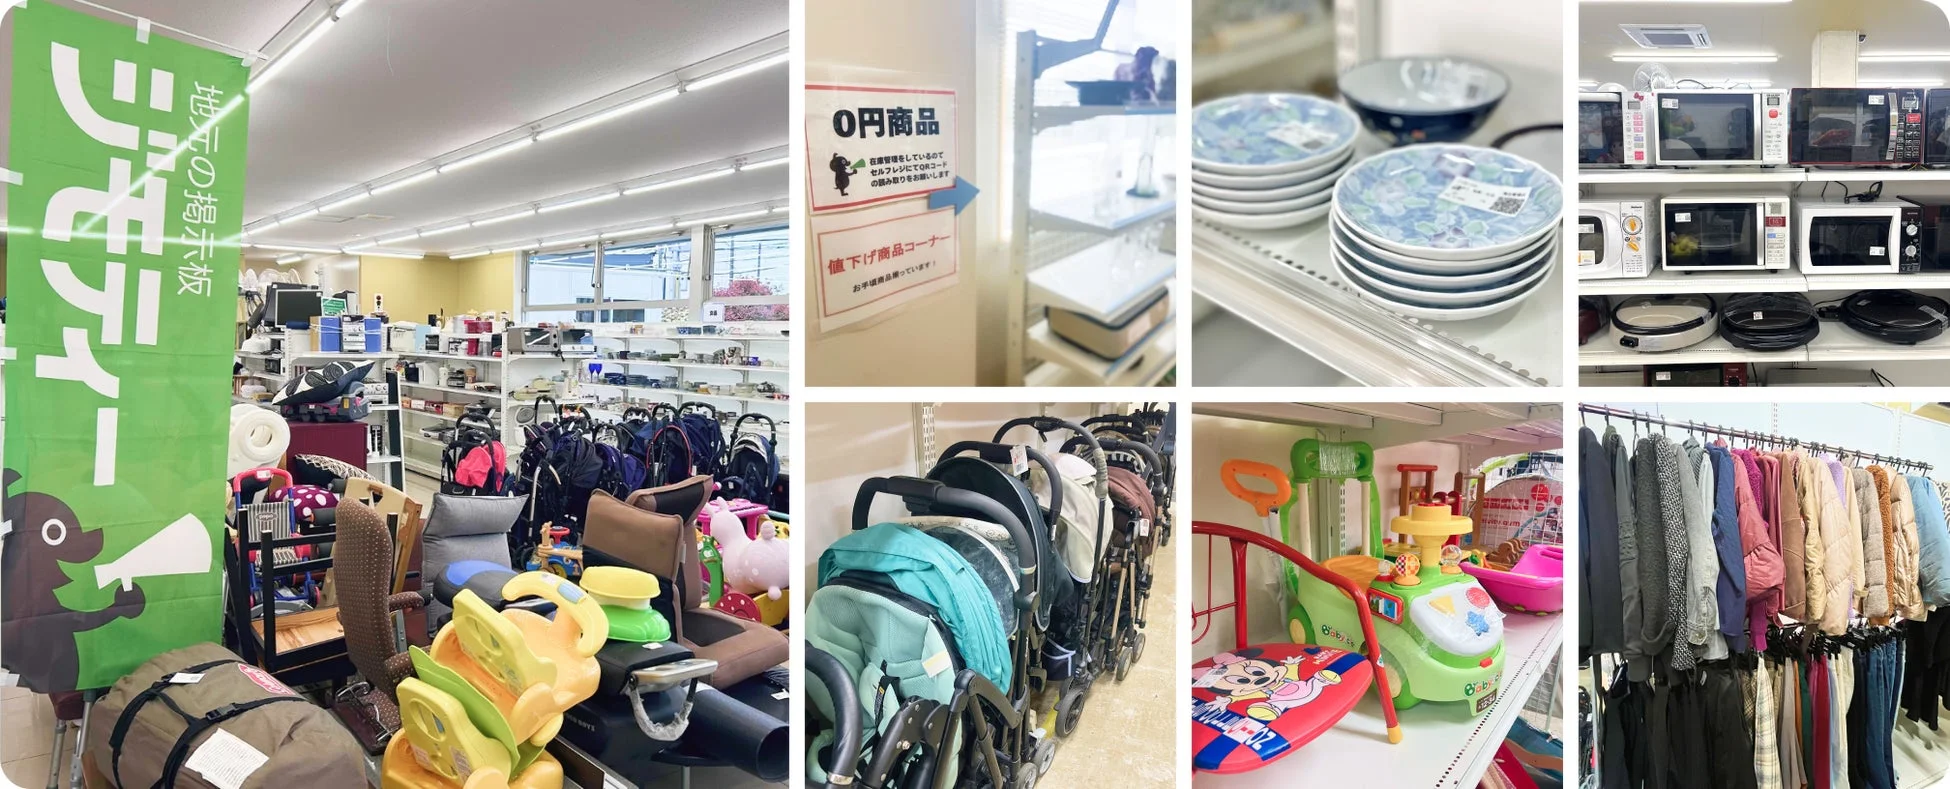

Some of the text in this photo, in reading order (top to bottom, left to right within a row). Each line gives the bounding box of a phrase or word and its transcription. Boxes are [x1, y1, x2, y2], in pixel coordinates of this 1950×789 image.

[832, 106, 940, 139] 0円商品
[869, 151, 944, 166] 在庫管理をしているので
[870, 161, 948, 177] セルフレジにてQRコード
[177, 80, 224, 298] 地元の掲示板
[870, 170, 949, 187] の読み取りをお願いします
[35, 41, 178, 486] ジモティー
[827, 234, 951, 276] 値下げ商品コーナー
